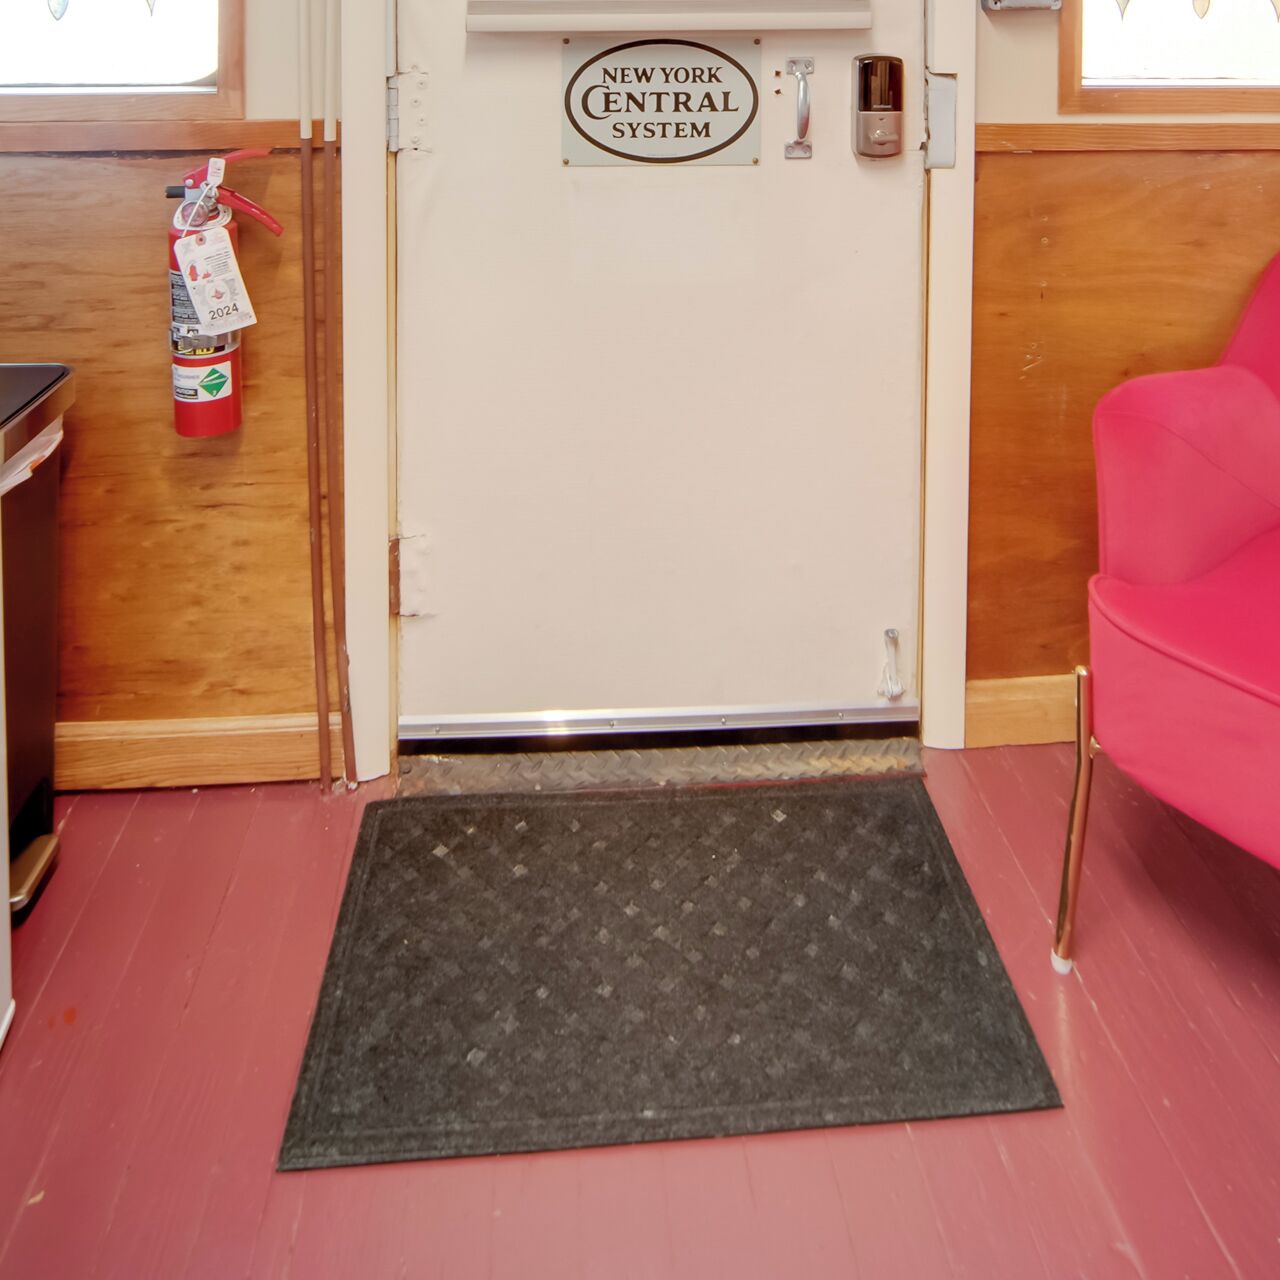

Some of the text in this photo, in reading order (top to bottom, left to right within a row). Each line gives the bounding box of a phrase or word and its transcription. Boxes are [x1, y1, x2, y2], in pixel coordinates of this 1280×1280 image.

[602, 66, 723, 84] NEW YORK
[581, 84, 740, 120] CENTRAL
[612, 121, 711, 139] SYSTEM
[208, 302, 240, 321] 2024
